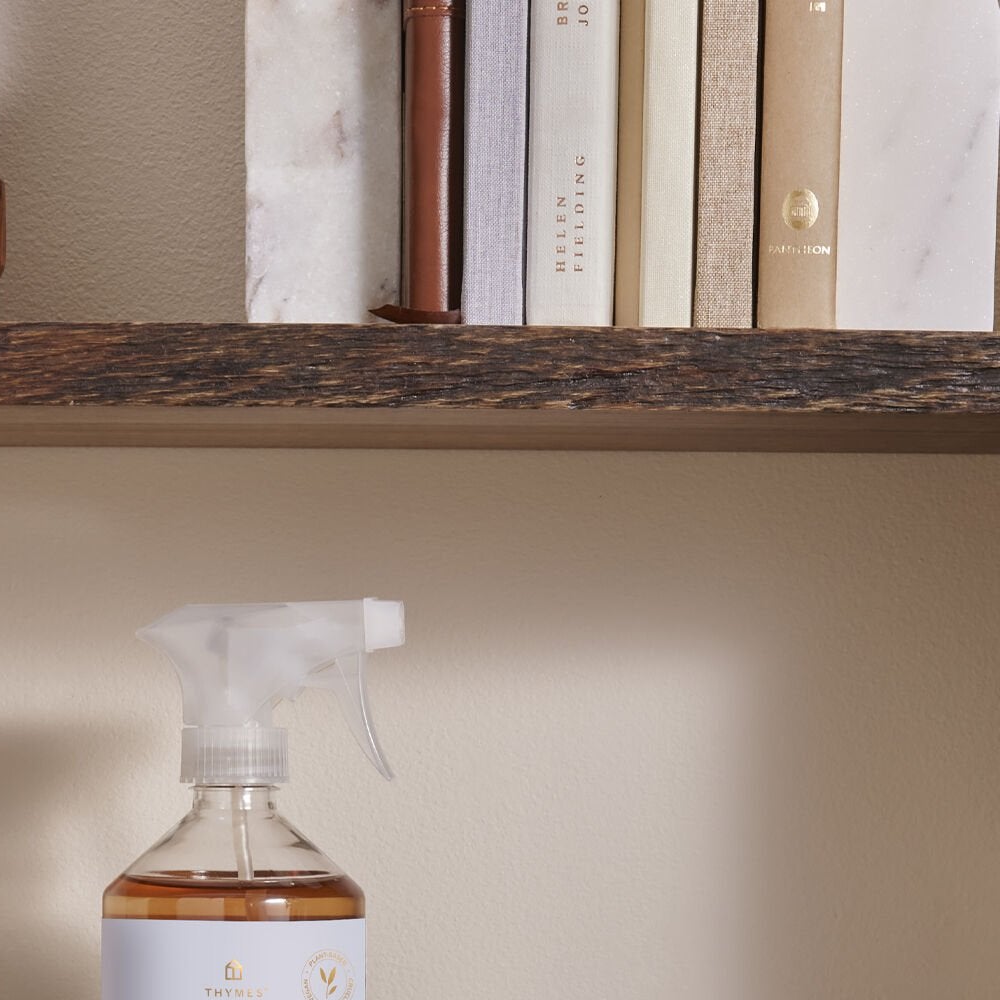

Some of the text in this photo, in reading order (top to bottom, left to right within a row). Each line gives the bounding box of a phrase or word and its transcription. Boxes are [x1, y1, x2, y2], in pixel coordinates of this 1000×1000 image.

[578, 4, 589, 26] JO
[556, 196, 567, 272] HELEN
[573, 155, 586, 272] FIELDING
[204, 988, 263, 998] THYMES
